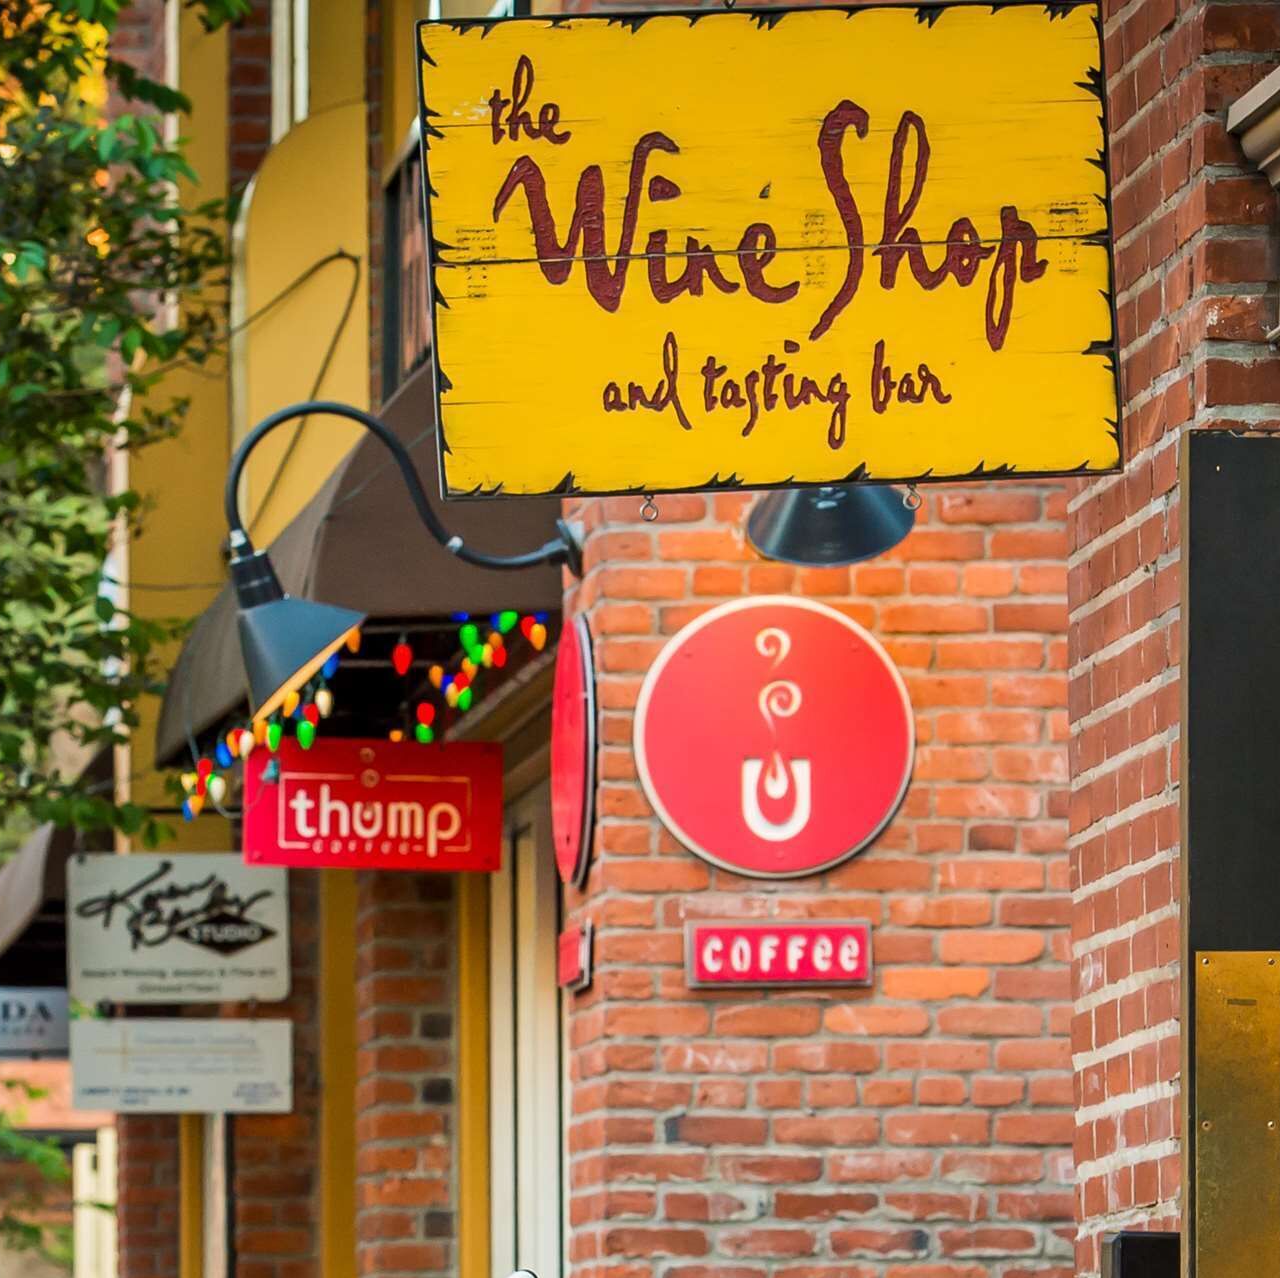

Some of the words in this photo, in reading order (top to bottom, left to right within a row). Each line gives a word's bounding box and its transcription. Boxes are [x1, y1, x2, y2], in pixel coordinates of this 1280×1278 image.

[489, 55, 572, 144] the
[494, 131, 801, 312] Wine
[808, 99, 1049, 351] Shop
[603, 331, 692, 430] and
[701, 338, 850, 450] tasting
[872, 339, 953, 413] bar
[289, 784, 461, 857] thump
[188, 923, 262, 943] STUDIO
